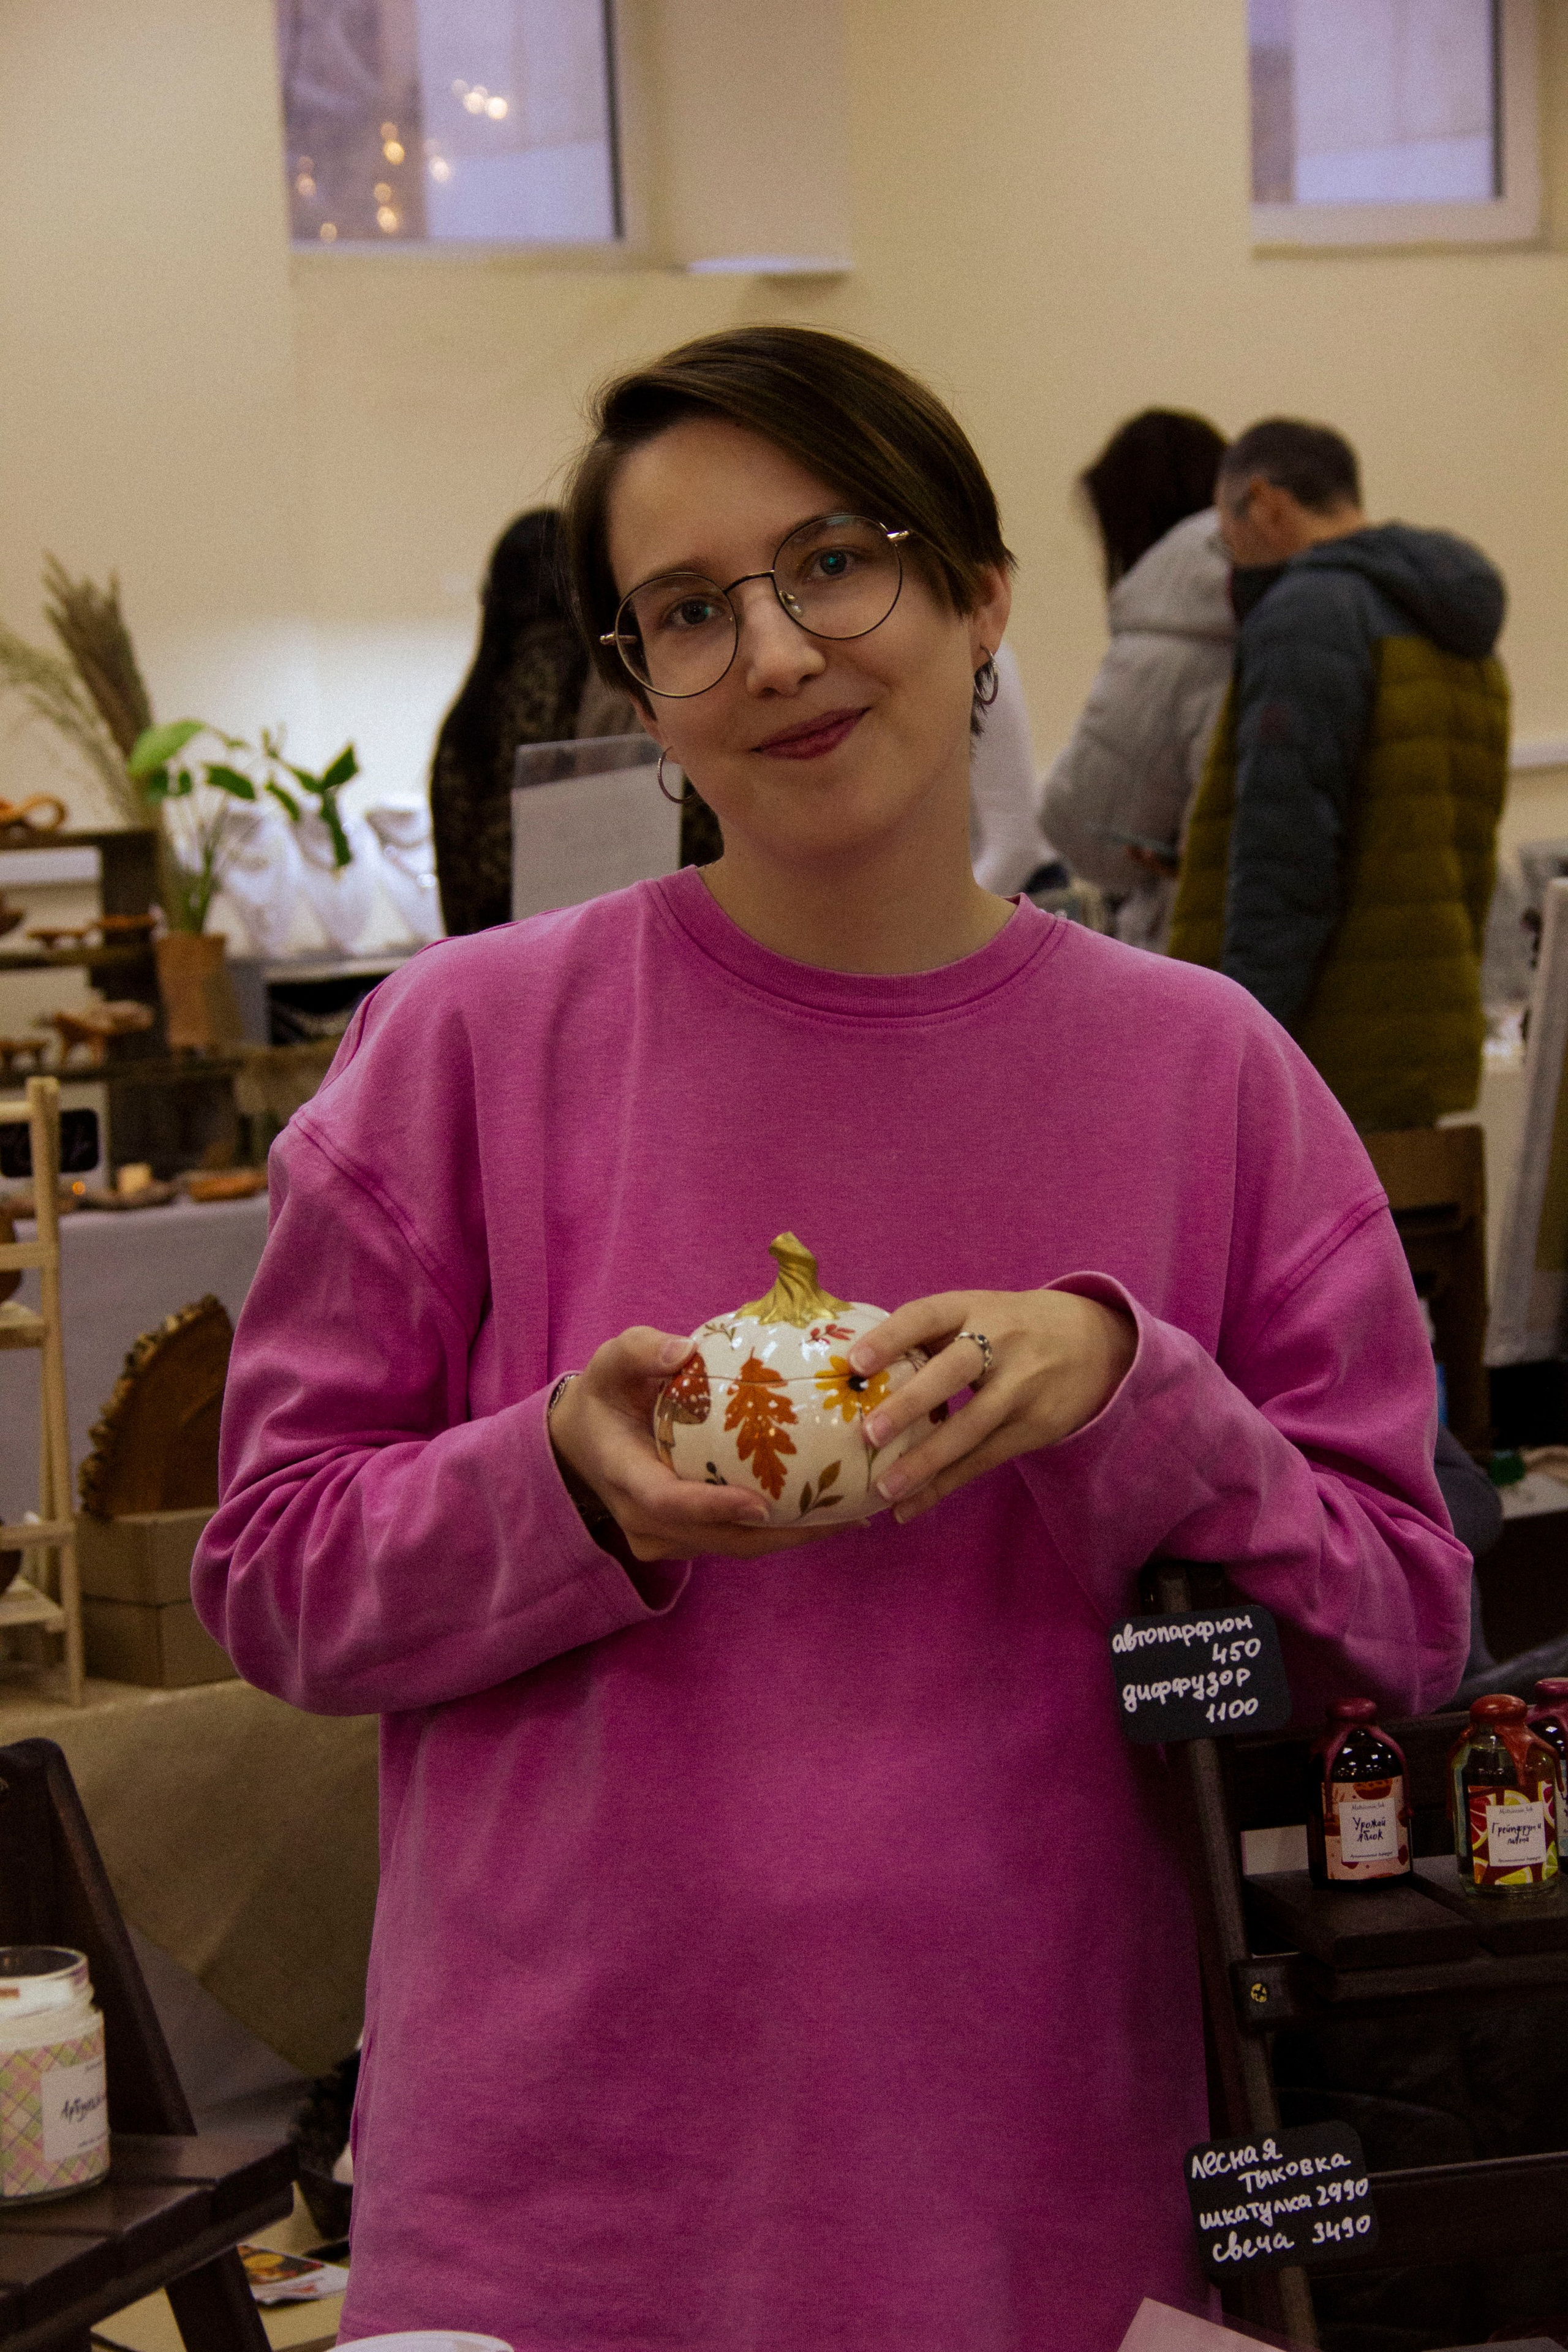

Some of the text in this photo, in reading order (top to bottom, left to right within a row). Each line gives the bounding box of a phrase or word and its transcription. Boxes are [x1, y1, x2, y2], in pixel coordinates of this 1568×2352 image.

[1112, 1615, 1254, 1654] автопарфюм
[1212, 1638, 1262, 1665] 450
[1122, 1668, 1251, 1713] диффузор
[1205, 1697, 1259, 1724] 1100
[1352, 1816, 1386, 1833] Урожай
[1199, 2177, 1369, 2230] шкатулка 2990
[1212, 2215, 1371, 2262] свеча 3490
